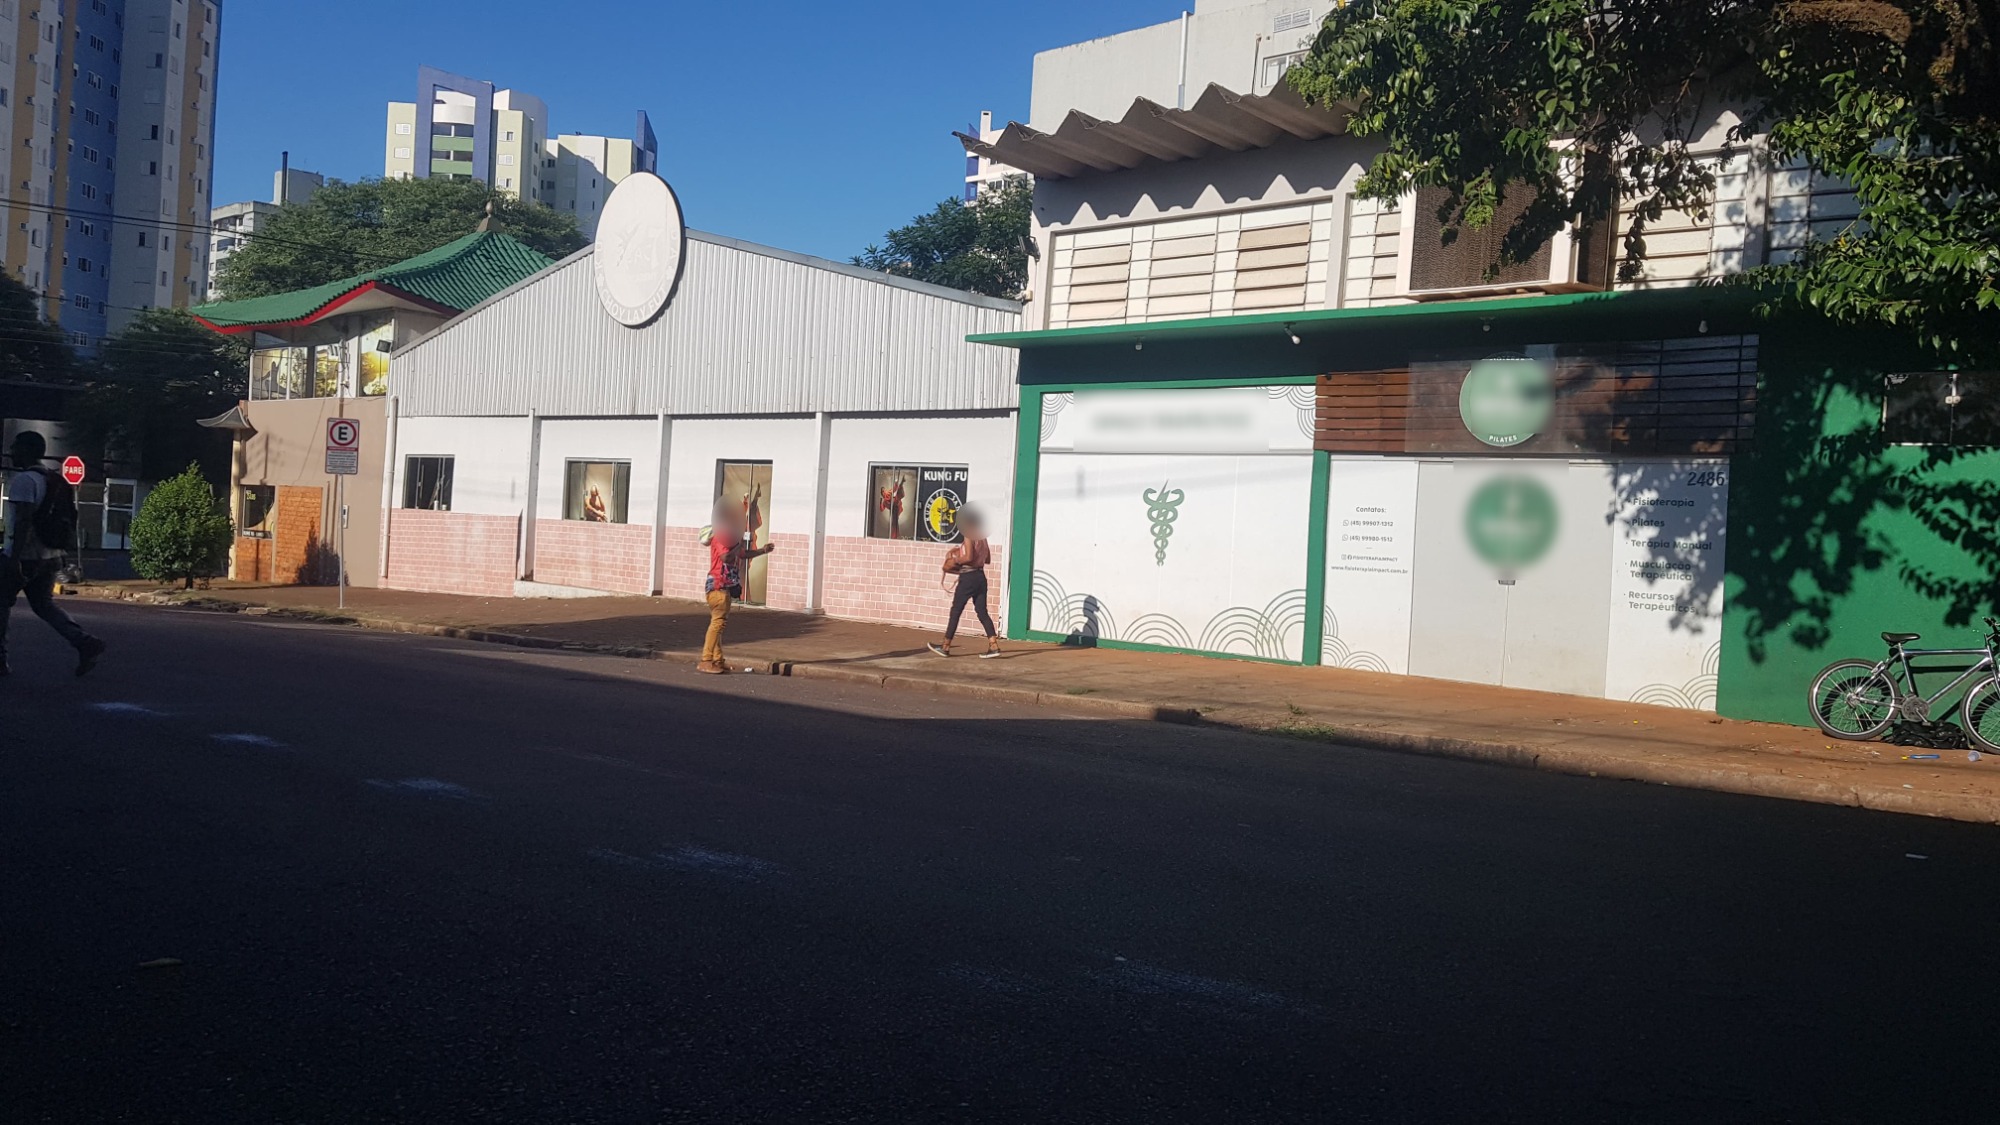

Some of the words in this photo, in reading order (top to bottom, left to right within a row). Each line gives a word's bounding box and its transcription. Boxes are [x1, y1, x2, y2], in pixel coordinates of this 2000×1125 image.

[602, 288, 626, 320] CHOY
[627, 307, 646, 323] LAY
[648, 287, 667, 310] FUT
[338, 426, 348, 441] E
[1488, 434, 1518, 443] PILATES
[924, 471, 952, 481] KUNG
[953, 471, 968, 482] FU
[1686, 471, 1726, 486] 2486
[1632, 497, 1695, 508] Fisioterapia
[1631, 518, 1666, 528] Pilates
[1630, 539, 1671, 550] Terapia
[1673, 541, 1713, 551] Manual
[1630, 570, 1693, 581] Terapêutica
[1628, 591, 1675, 601] Recursos
[1628, 602, 1696, 613] Terapêuticos
